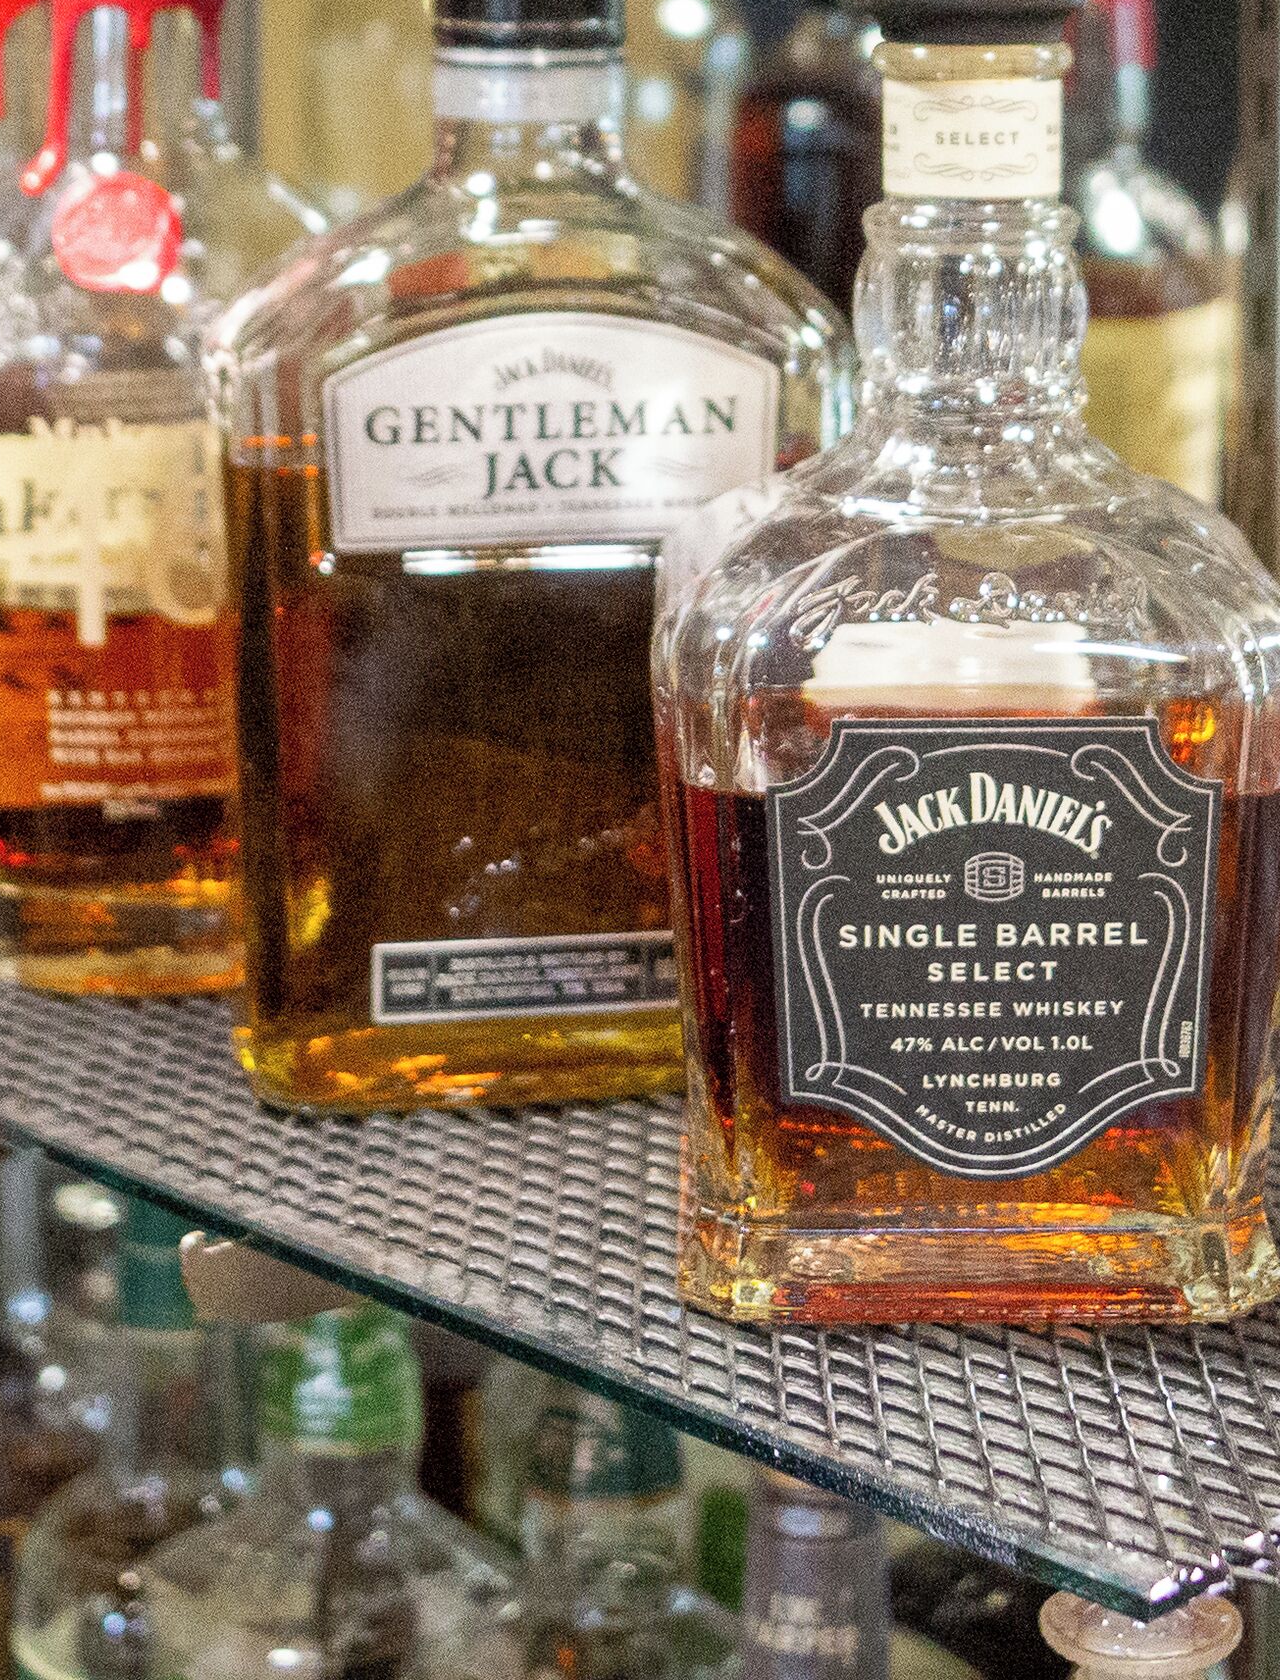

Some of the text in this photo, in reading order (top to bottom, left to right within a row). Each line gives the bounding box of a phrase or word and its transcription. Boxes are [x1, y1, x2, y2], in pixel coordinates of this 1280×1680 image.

[935, 131, 1020, 146] SELECT
[364, 395, 738, 446] GENTLEMAN
[482, 447, 625, 500] JACK
[873, 772, 1113, 856] JACK DANIEL'S
[876, 874, 951, 886] UNIQUELY
[1034, 872, 1113, 883] HANDMADE
[881, 888, 947, 900] CRAFTED
[1042, 887, 1105, 898] BARRELS
[838, 922, 1149, 948] SINGLE BARREL
[927, 961, 1058, 982] SELECT
[860, 1000, 1125, 1020] TENNESSEE WHISKEY
[890, 1036, 933, 1052] 47%
[1051, 1034, 1093, 1051] 1.0L
[922, 1072, 1062, 1089] LYNCHBURG
[965, 1100, 1020, 1113] TENN.
[914, 1103, 1067, 1143] MASTER DISTILLED
